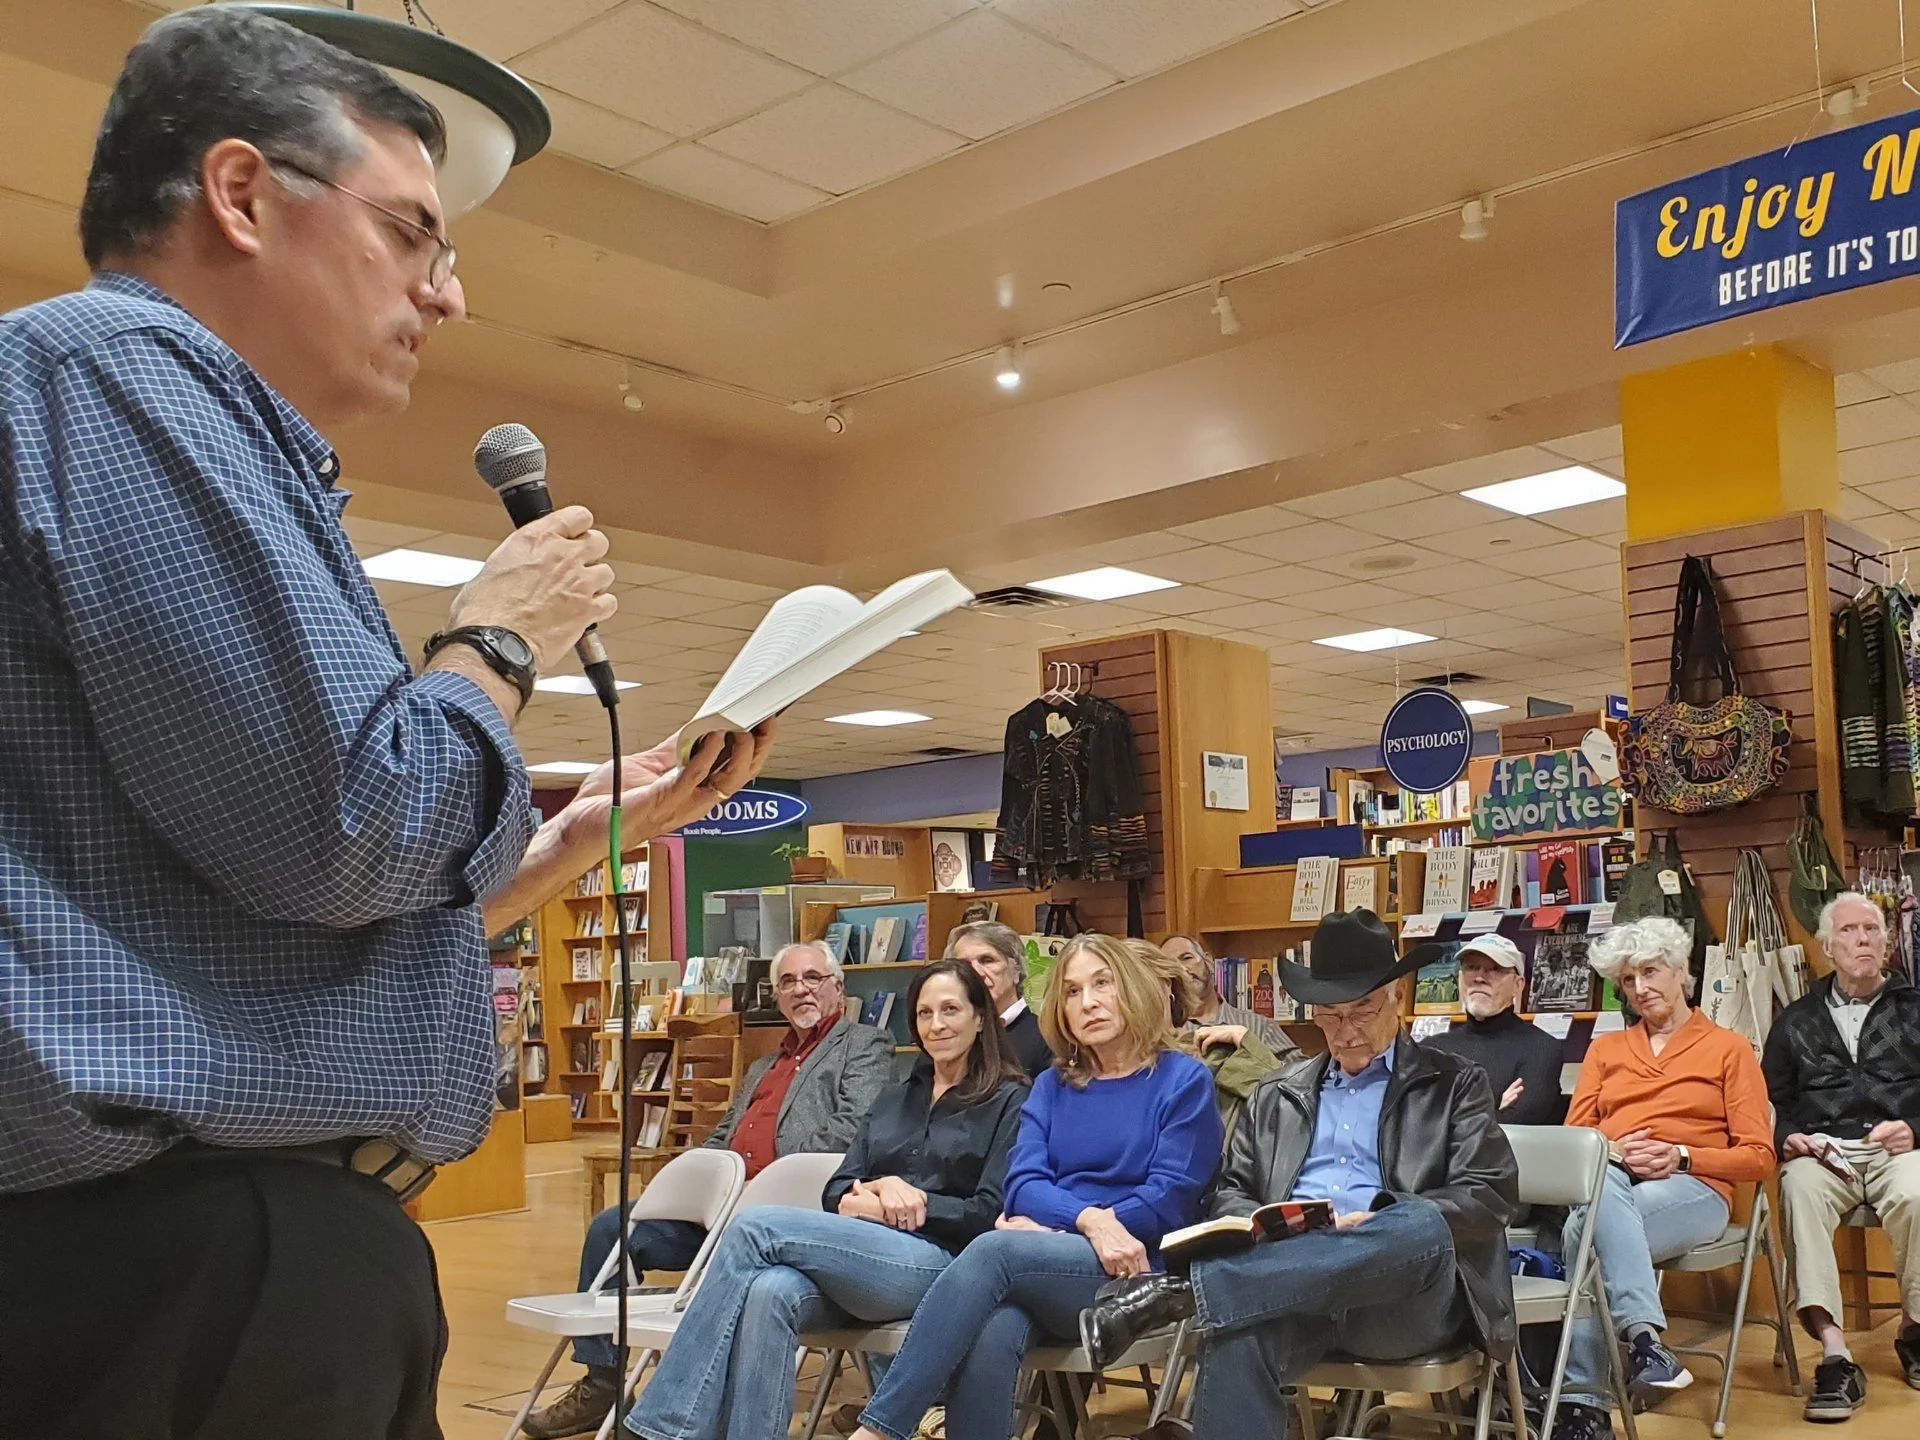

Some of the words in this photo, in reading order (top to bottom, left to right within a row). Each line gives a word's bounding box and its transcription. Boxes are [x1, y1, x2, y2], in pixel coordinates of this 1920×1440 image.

[1656, 171, 1835, 260] Enjoy
[1718, 251, 1812, 306] BEFORE
[1827, 236, 1873, 278] IT'S
[1387, 729, 1466, 753] PSYCHOLOGY
[1495, 752, 1592, 795] fresh
[701, 800, 779, 821] OOMS
[1472, 790, 1620, 831] favorites
[1434, 850, 1456, 861] THE
[1303, 860, 1321, 870] THE
[1430, 861, 1458, 871] BODY
[1299, 871, 1321, 880] BODY
[1425, 898, 1457, 906] BRYSON
[1433, 890, 1451, 898] BILL
